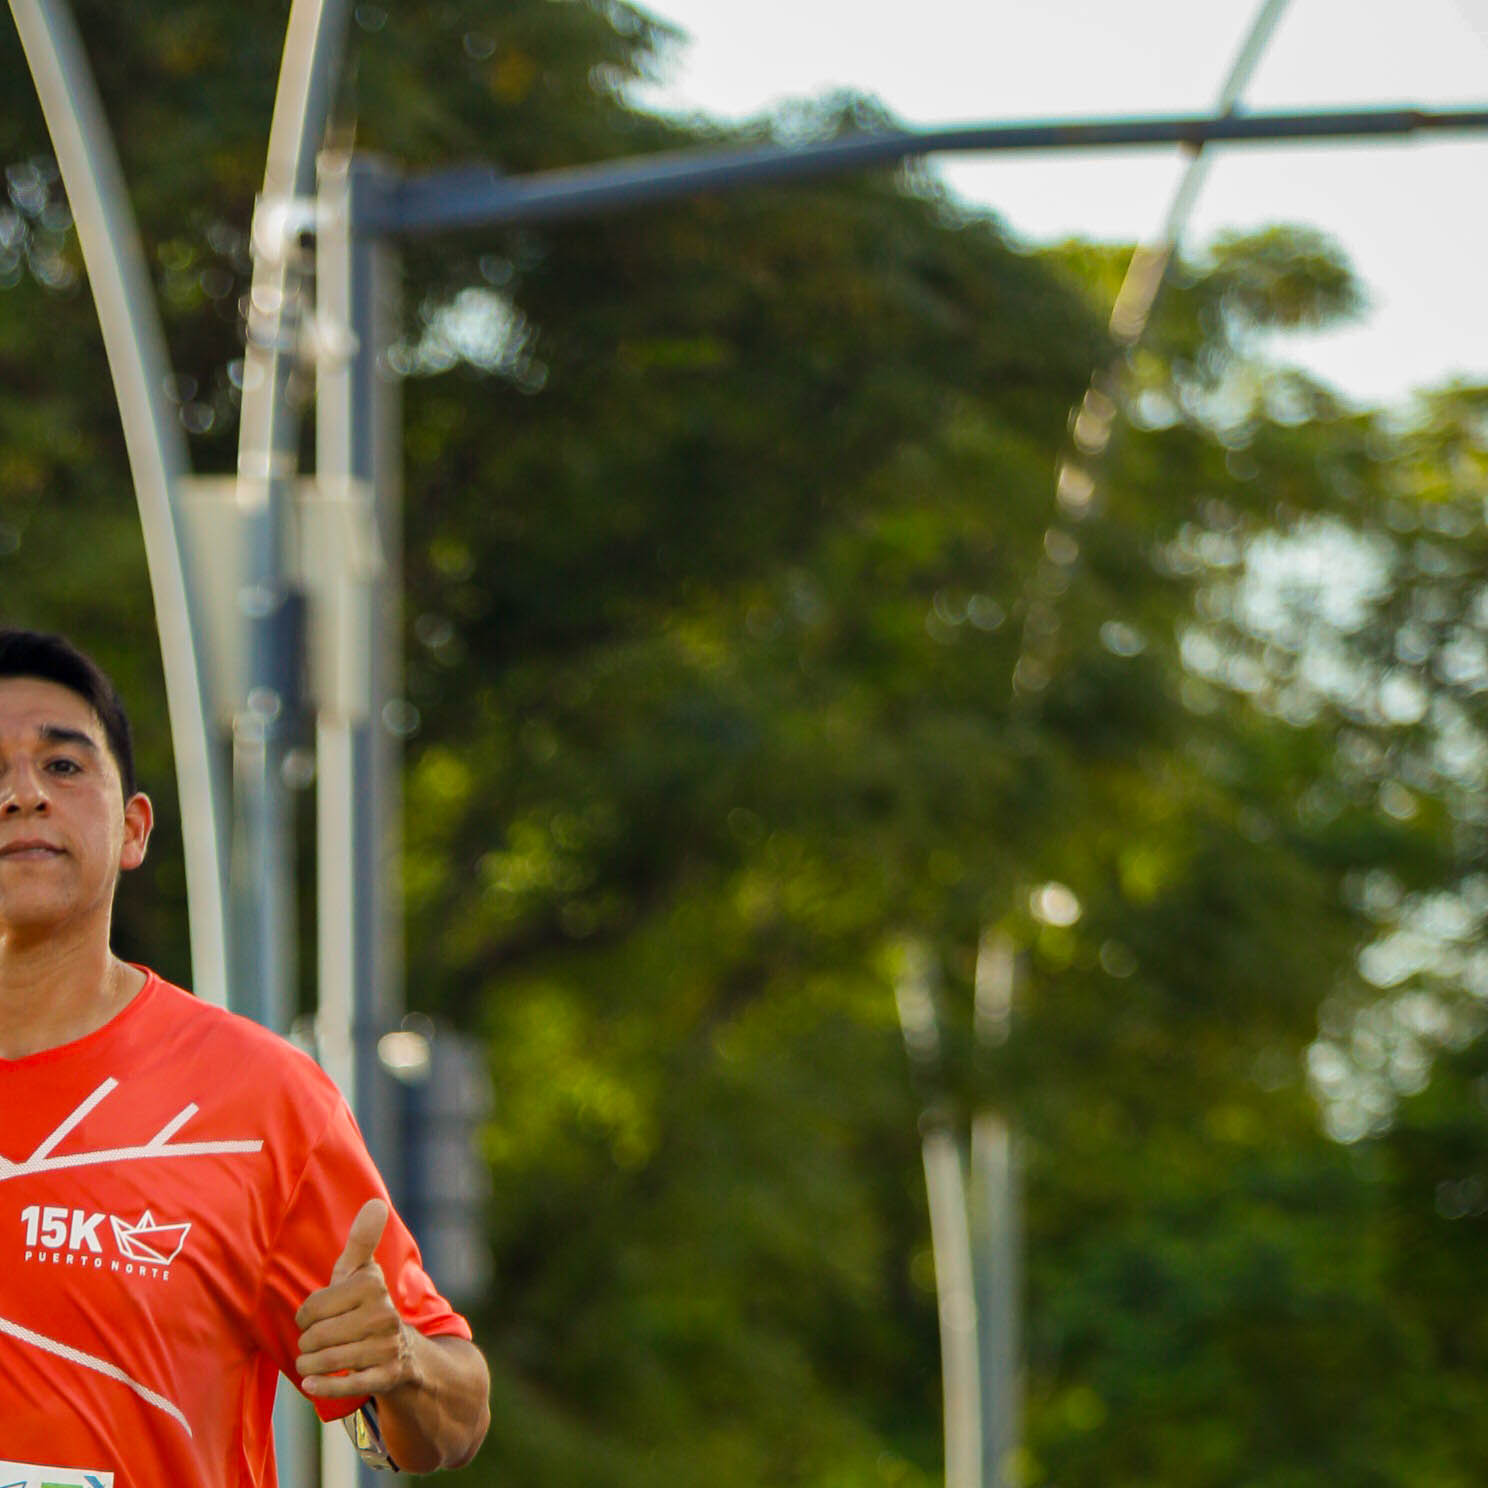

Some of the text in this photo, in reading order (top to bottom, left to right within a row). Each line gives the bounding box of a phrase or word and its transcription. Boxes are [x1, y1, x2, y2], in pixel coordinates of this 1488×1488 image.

[21, 1205, 106, 1253] 15K
[25, 1251, 170, 1281] PUERTO NORTE
